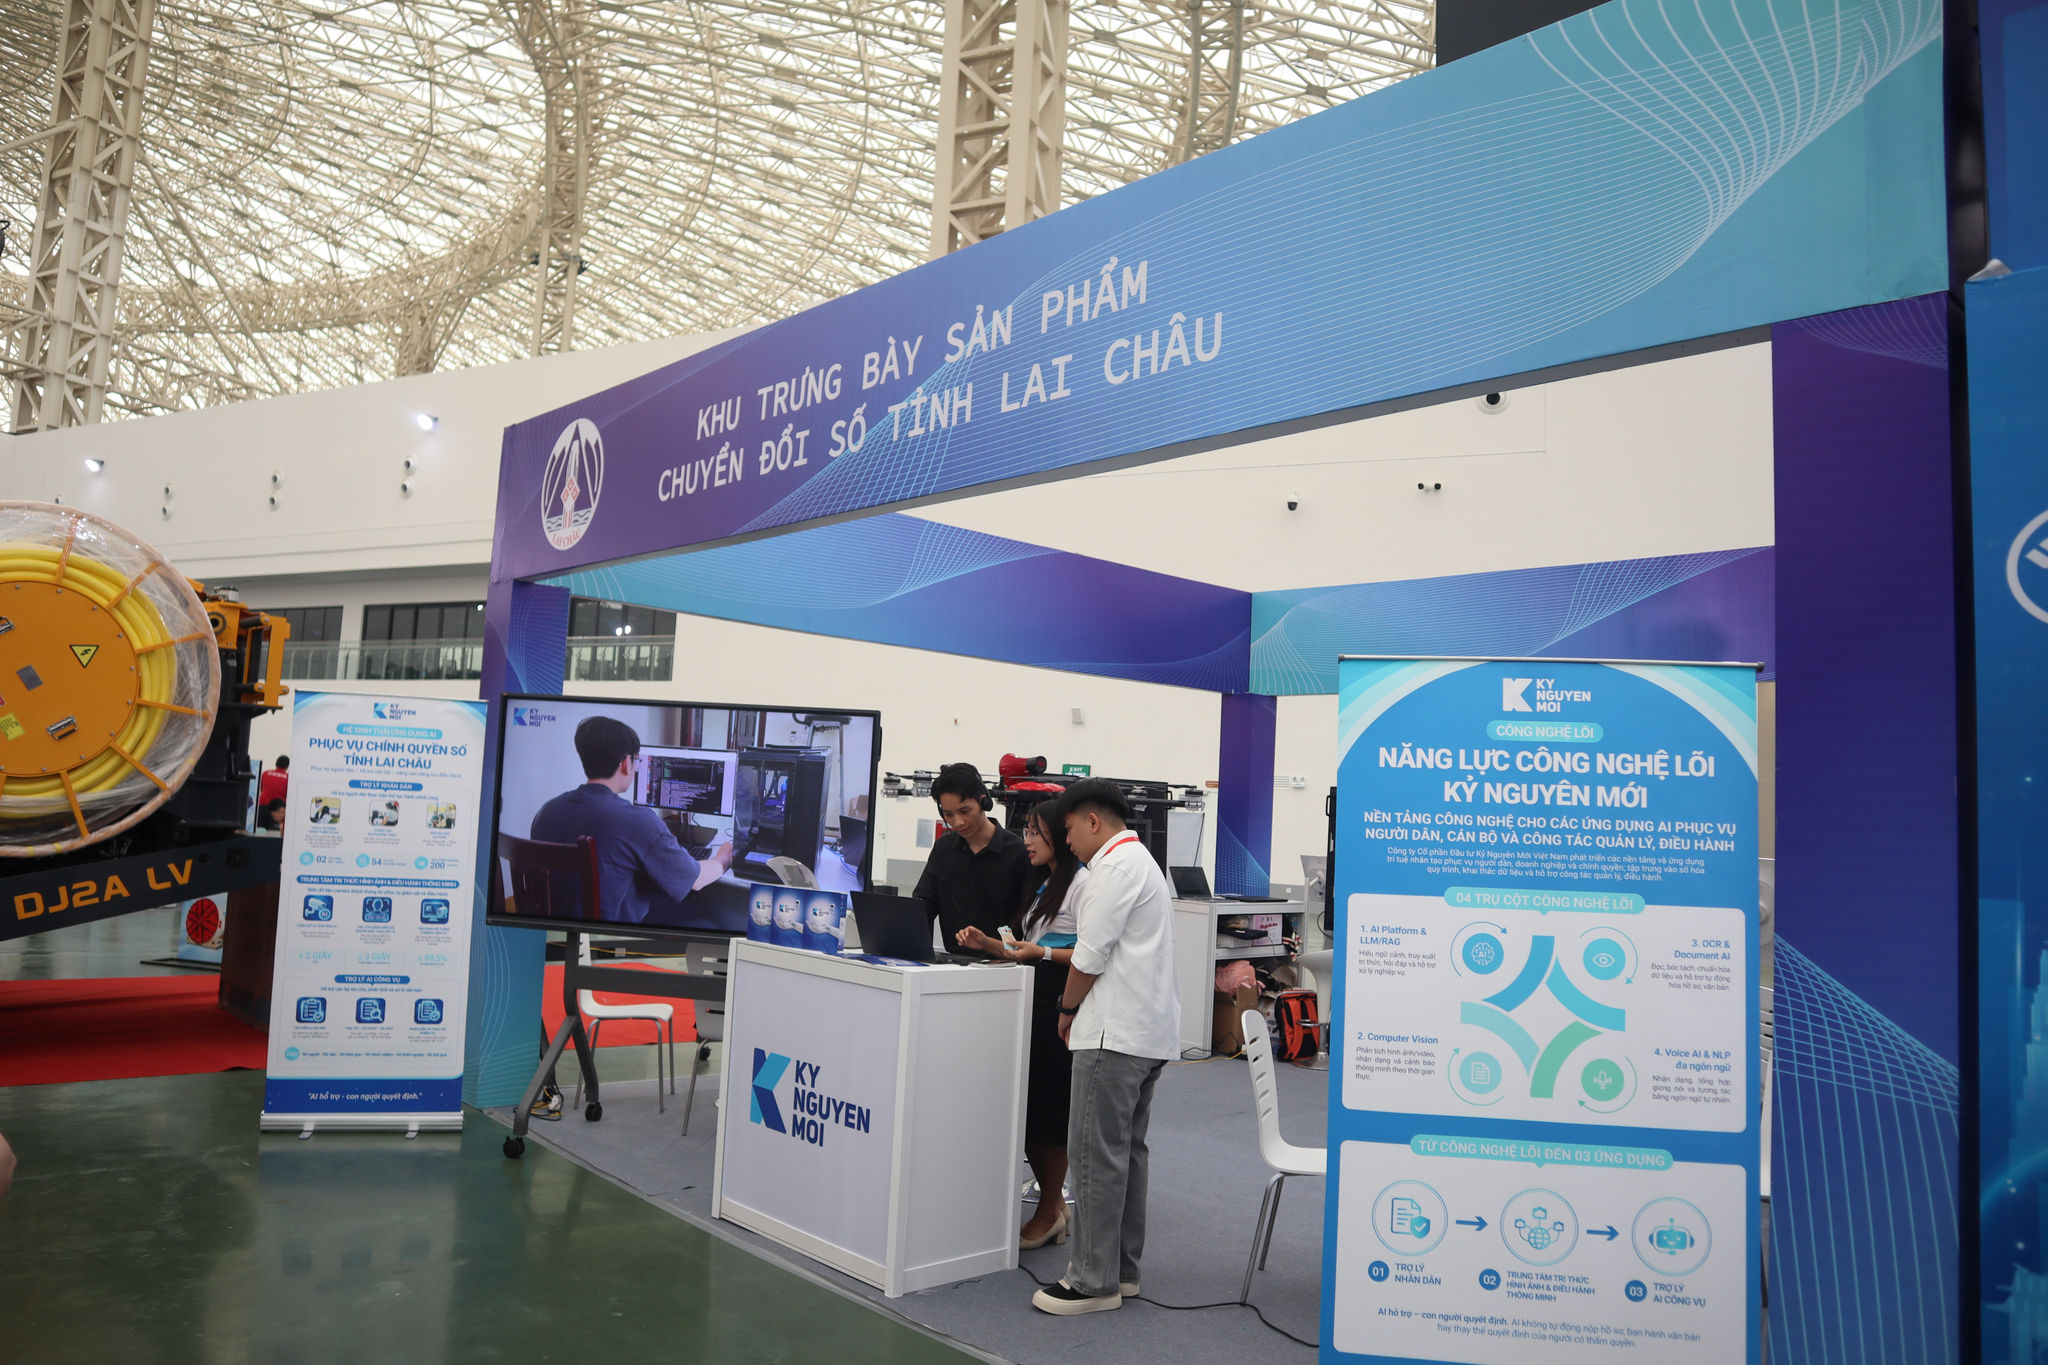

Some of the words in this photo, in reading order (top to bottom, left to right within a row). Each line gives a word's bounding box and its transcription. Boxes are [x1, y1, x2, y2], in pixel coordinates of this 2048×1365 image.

[696, 395, 740, 440] KHU
[757, 364, 843, 420] TRƯNG
[862, 335, 924, 389] BÀY
[944, 304, 1015, 364] SẢN
[1041, 256, 1150, 334] PHẨM
[658, 441, 744, 502] CHUYỂN
[759, 422, 810, 475] ĐỔI
[829, 403, 867, 458] SỐ
[888, 383, 973, 438] TỈNH
[1001, 354, 1073, 413] LAI
[1105, 311, 1225, 385] CHÂU
[1536, 679, 1554, 689] KY
[1536, 690, 1591, 703] NGUYEN
[1536, 701, 1560, 712] MOI
[529, 714, 556, 722] NGUYEN
[1496, 724, 1533, 737] CÔNG
[1535, 724, 1572, 740] NGHỆ
[1574, 725, 1593, 738] LÕI
[309, 738, 344, 751] PHỤC
[346, 740, 363, 752] VỤ
[366, 740, 404, 752] CHÍNH
[407, 743, 448, 755] QUYỀN
[451, 745, 467, 756] SỐ
[1379, 742, 1452, 769] NĂNG
[1459, 749, 1510, 776] LỰC
[1516, 746, 1590, 773] CÔNG
[1596, 749, 1669, 781] NGHỆ
[1675, 750, 1714, 777] LÕI
[1444, 775, 1478, 802] KỶ
[1484, 779, 1590, 806] NGUYÊN
[1597, 781, 1647, 808] MỚI
[1364, 809, 1391, 823] NỀN
[1394, 810, 1431, 824] TẢNG
[1435, 811, 1473, 826] CÔNG
[1477, 814, 1514, 830] NGHỆ
[1517, 816, 1546, 828] CHO
[1550, 815, 1578, 829] CÁC
[1582, 816, 1611, 830] ỨNG
[1616, 820, 1654, 834] DỤNG
[1658, 821, 1671, 832] AI
[1675, 822, 1713, 836] PHỤC
[1717, 823, 1736, 837] VỤ
[1365, 827, 1408, 840] NGƯỜI
[1412, 828, 1443, 843] DÂN,
[1447, 829, 1475, 842] CÁN
[1479, 830, 1497, 846] BỘ
[1501, 831, 1519, 844] VÀ
[1523, 831, 1562, 845] CÔNG
[1565, 833, 1592, 846] TÁC
[1596, 834, 1634, 848] QUẢN
[1639, 835, 1655, 850] LÝ,
[1659, 836, 1690, 850] ĐIỀU
[1694, 837, 1734, 851] HÀNH
[430, 861, 445, 869] 200
[14, 875, 130, 920] DJ2A
[147, 859, 192, 890] LV
[1456, 892, 1471, 904] 04
[1474, 891, 1500, 907] TRỤ
[1503, 892, 1530, 908] CỘT
[1533, 894, 1570, 907] CÔNG
[1573, 896, 1609, 911] NGHỆ
[1613, 897, 1632, 910] LÕI
[1370, 925, 1380, 933] AI
[1382, 925, 1418, 935] Platform
[1420, 927, 1427, 936] &
[1360, 936, 1401, 946] LLM/RAG
[1692, 939, 1699, 947] 3.
[1702, 939, 1722, 948] OCR
[1724, 940, 1730, 949] &
[1674, 950, 1719, 960] Document
[1721, 952, 1730, 960] AI
[1358, 1032, 1365, 1040] 2.
[1367, 1032, 1410, 1044] Computer
[1412, 1035, 1438, 1044] Vision
[1654, 1048, 1662, 1056] 4.
[1665, 1048, 1690, 1058] Voice
[1692, 1050, 1701, 1058] AI
[1704, 1050, 1710, 1059] &
[1712, 1050, 1731, 1060] NLP
[795, 1060, 820, 1088] KY
[1676, 1061, 1688, 1070] đa
[1689, 1062, 1712, 1072] ngôn
[1714, 1063, 1731, 1074] ngữ
[793, 1087, 870, 1134] NGUYEN
[792, 1114, 824, 1147] MOI
[1418, 1138, 1438, 1152] TỪ
[1440, 1140, 1476, 1154] CÔNG
[1480, 1143, 1517, 1159] NGHỆ
[1520, 1145, 1540, 1158] LÕI
[1544, 1146, 1570, 1160] ĐẾN
[1575, 1150, 1590, 1162] 03
[1594, 1148, 1622, 1163] ỨNG
[1627, 1153, 1664, 1167] DỤNG
[1372, 1267, 1384, 1277] 01
[1396, 1263, 1413, 1273] TRỢ
[1415, 1264, 1425, 1272] LÝ
[1395, 1275, 1421, 1284] NHÂN
[1422, 1276, 1441, 1285] DÂN
[1483, 1275, 1496, 1285] 02
[1629, 1286, 1643, 1297] 03
[1654, 1282, 1672, 1294] TRỢ
[1674, 1283, 1684, 1293] LÝ
[1507, 1291, 1534, 1300] THÔNG
[1535, 1293, 1556, 1301] MINH
[1653, 1295, 1662, 1303] AI
[1664, 1295, 1691, 1306] CÔNG
[1693, 1298, 1706, 1308] VỤ
[1388, 1308, 1399, 1316] hỗ
[1400, 1310, 1412, 1319] trợ
[1438, 1313, 1462, 1322] người
[1463, 1316, 1486, 1325] quyết
[1488, 1316, 1510, 1326] định.
